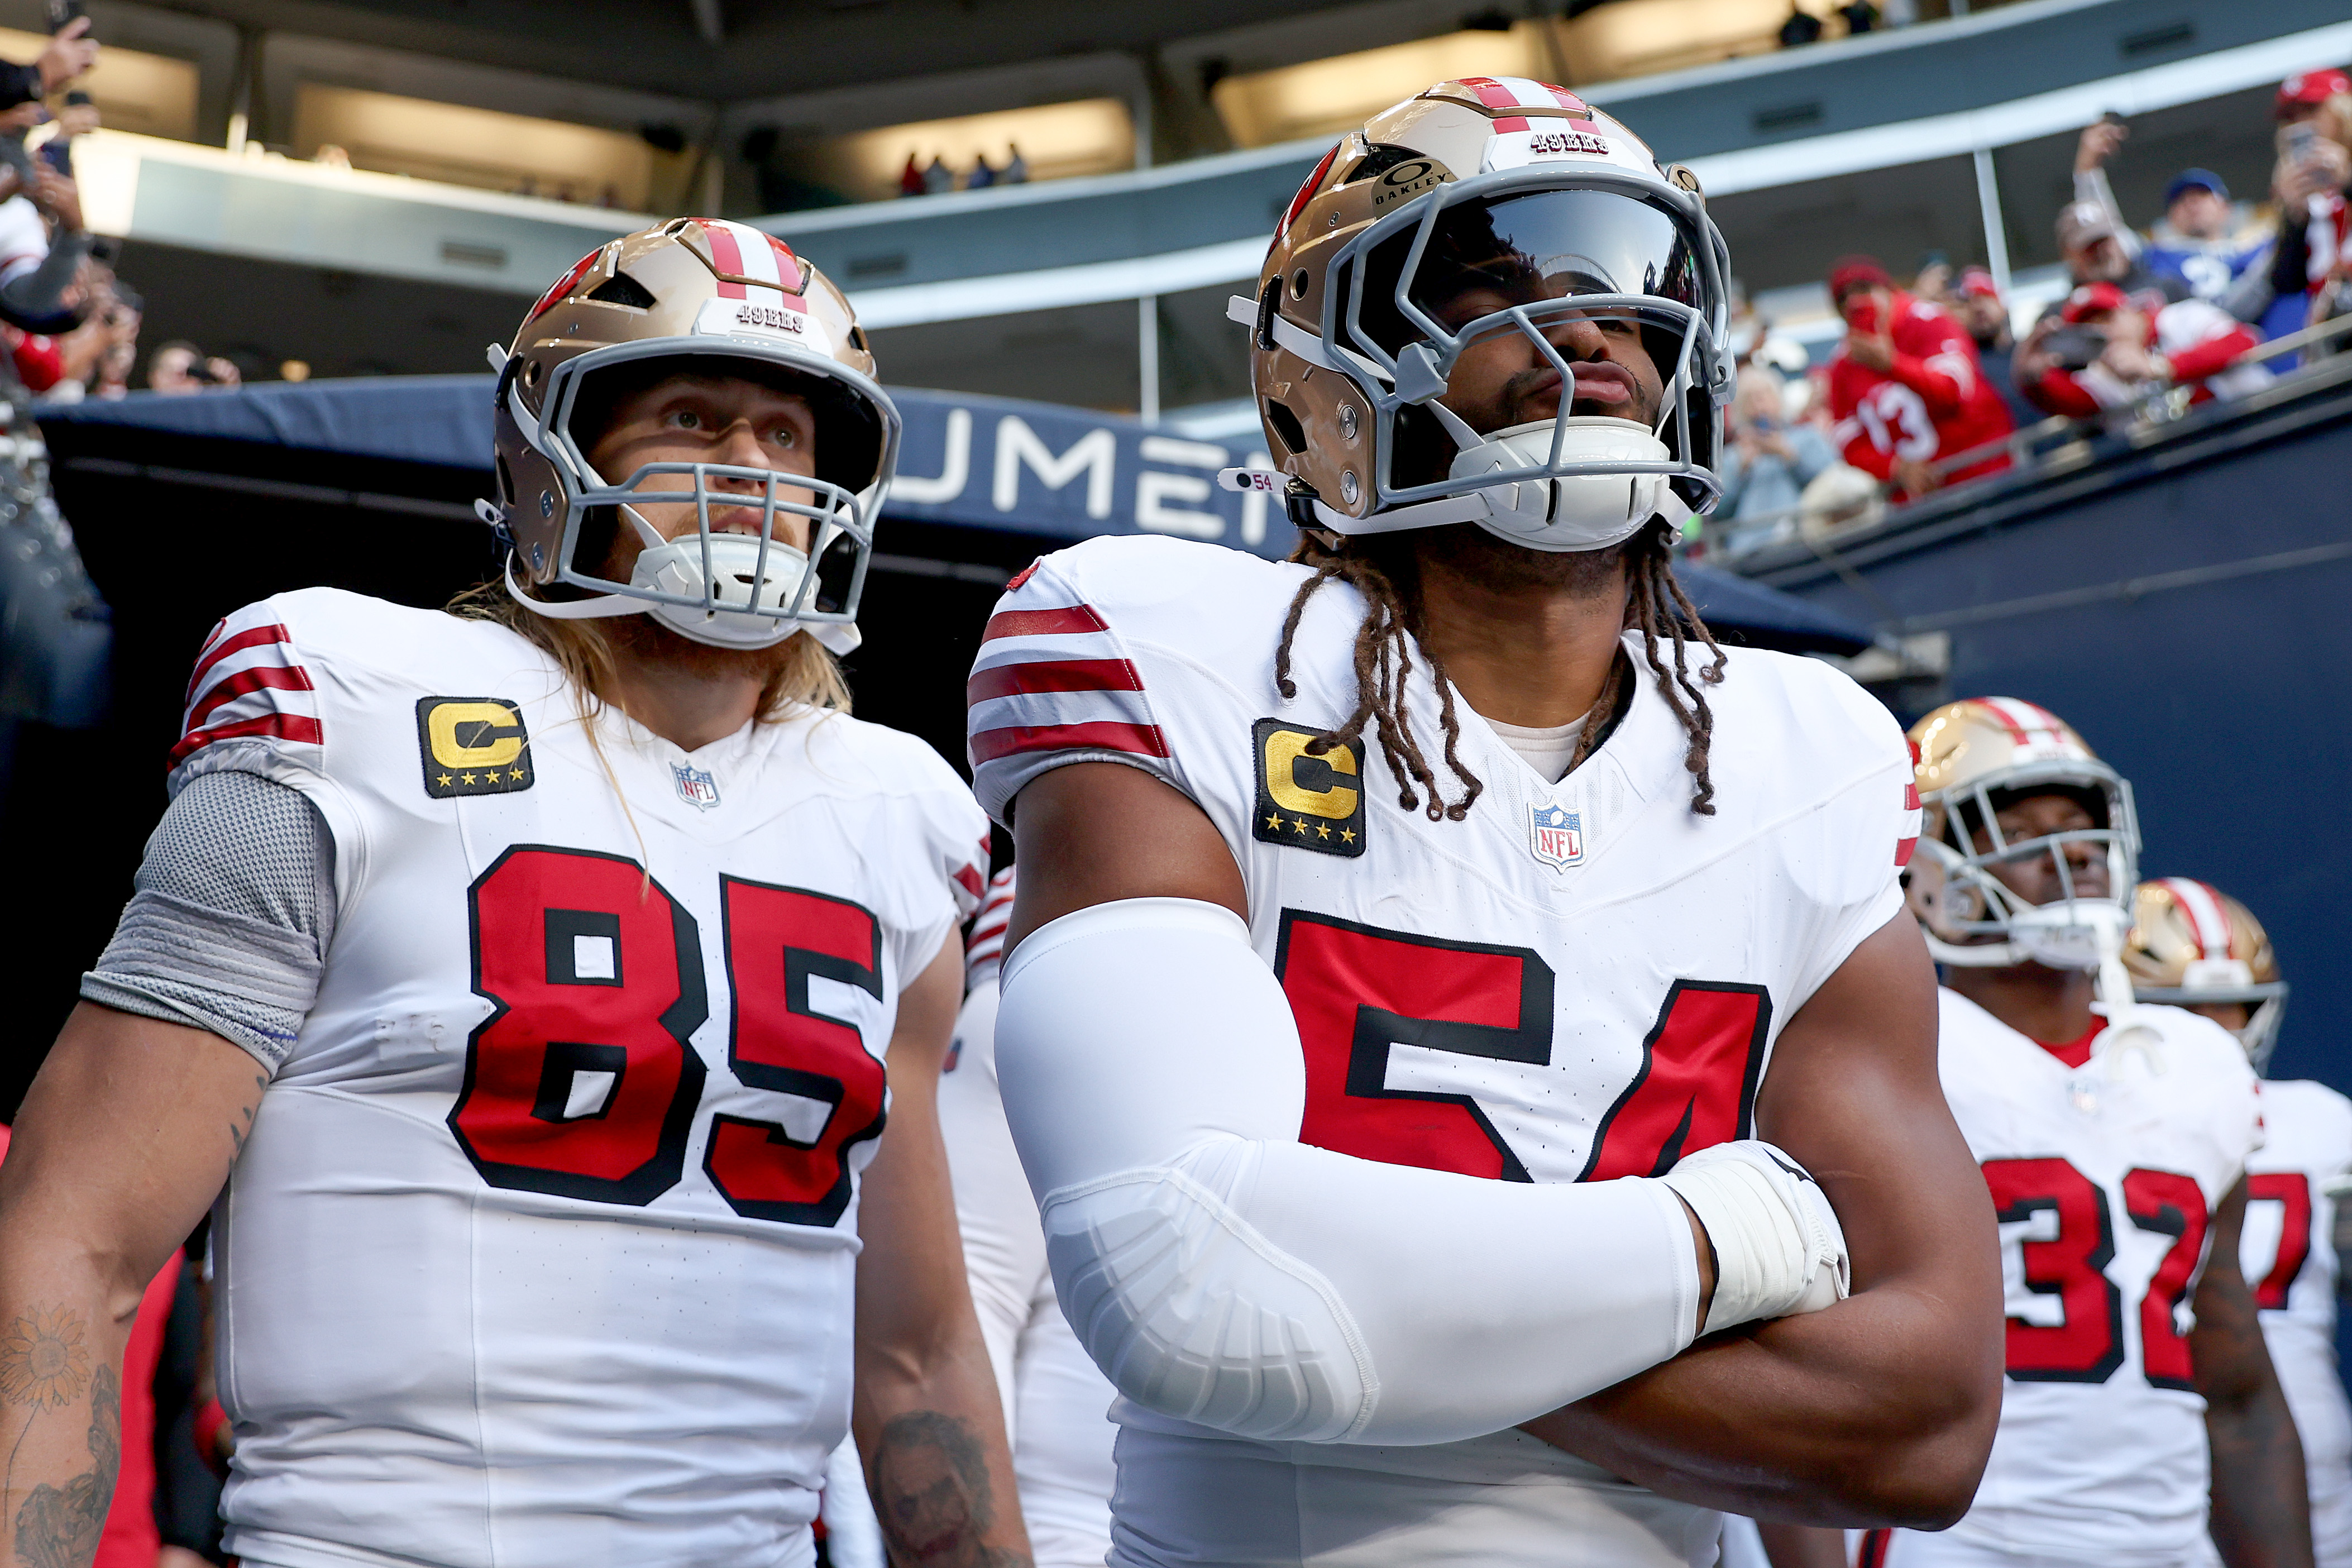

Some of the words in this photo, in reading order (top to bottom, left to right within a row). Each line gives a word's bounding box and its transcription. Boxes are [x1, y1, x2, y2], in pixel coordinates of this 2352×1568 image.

[1530, 133, 1610, 154] 49ERS
[1375, 173, 1447, 205] OAKLEY
[737, 305, 804, 333] 49ERS
[1253, 474, 1273, 490] 54
[428, 702, 522, 769] C
[681, 780, 714, 800] NFL
[1265, 730, 1357, 820] C
[1540, 829, 1579, 859] NFL
[446, 843, 887, 1228] 85
[1980, 1157, 2208, 1393] 32
